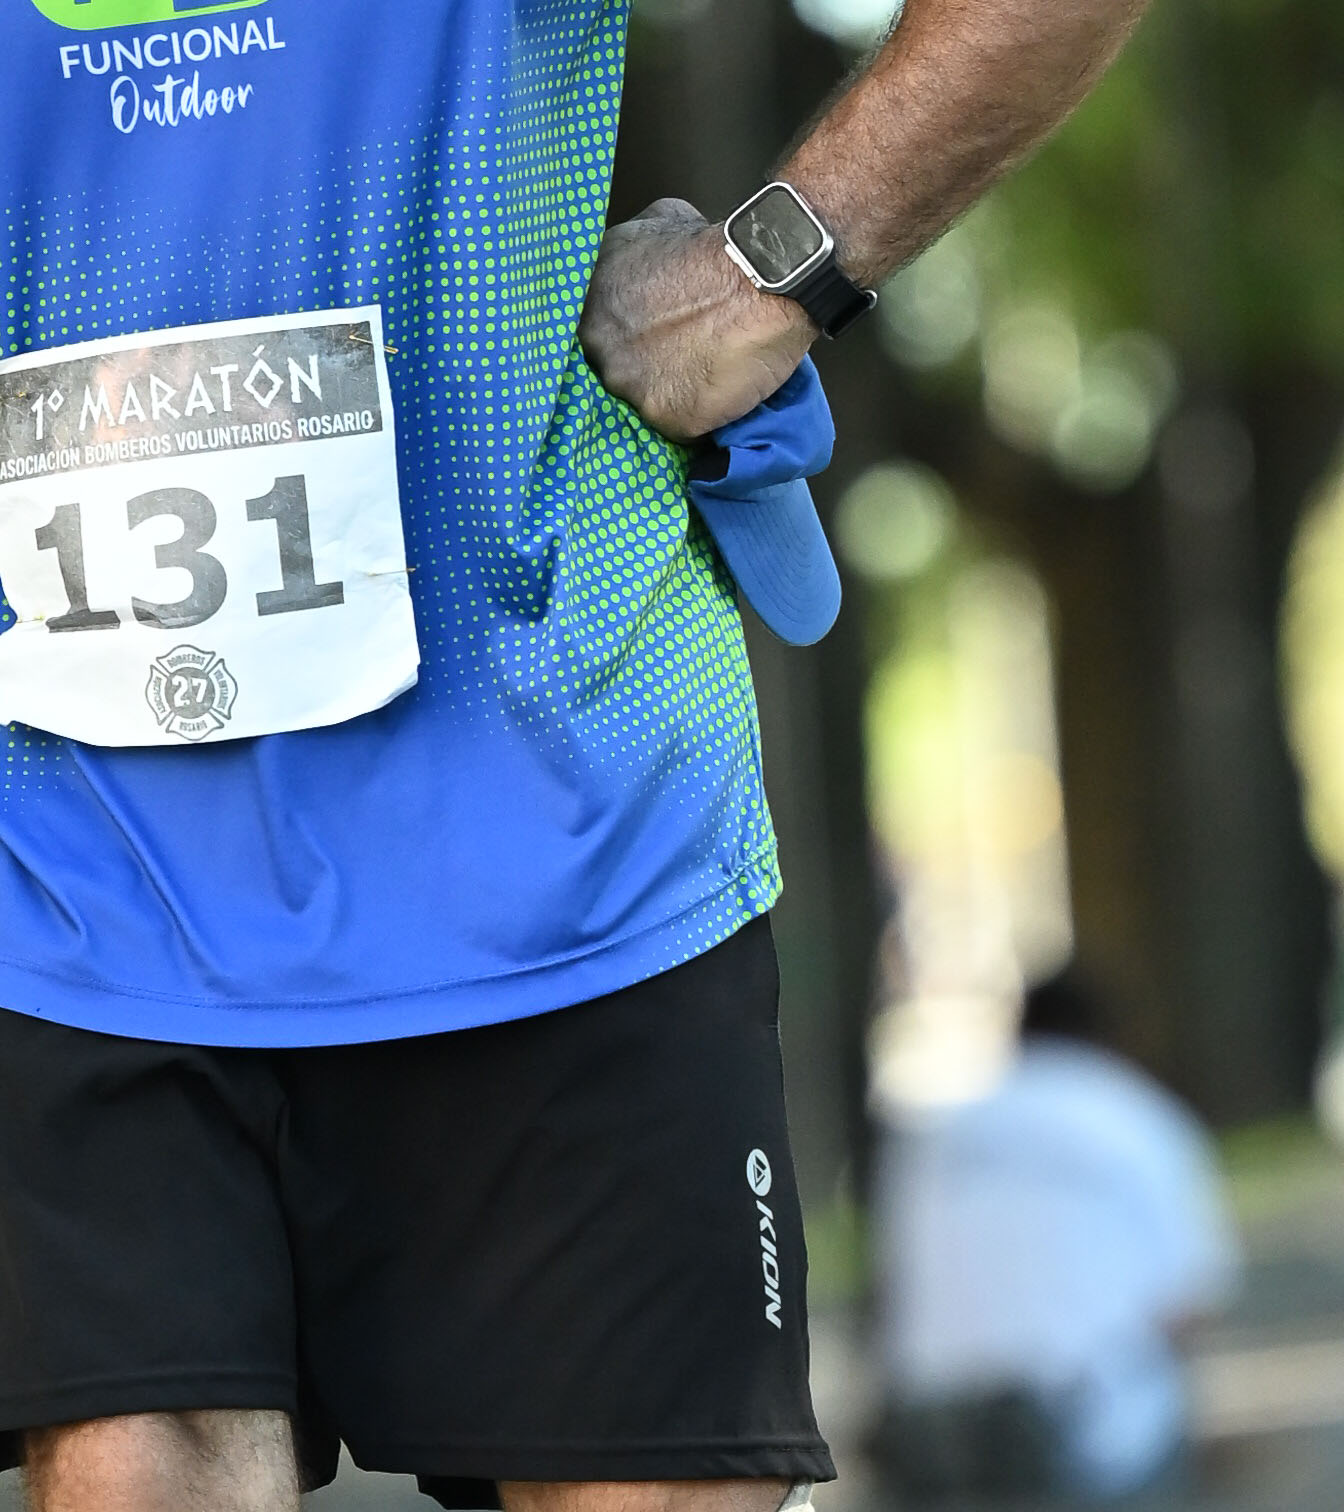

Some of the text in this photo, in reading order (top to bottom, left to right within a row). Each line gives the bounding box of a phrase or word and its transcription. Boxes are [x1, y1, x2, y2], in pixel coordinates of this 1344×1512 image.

[59, 17, 286, 79] FUNCIONAL
[110, 70, 255, 134] Outdoor
[79, 344, 322, 431] MARATÓN
[85, 433, 171, 464] BOMBEROS
[175, 420, 293, 452] VOLUNTARIOS
[297, 410, 373, 437] ROSARIO
[35, 474, 344, 633] 131
[172, 675, 207, 708] 27
[756, 1200, 781, 1329] KION
